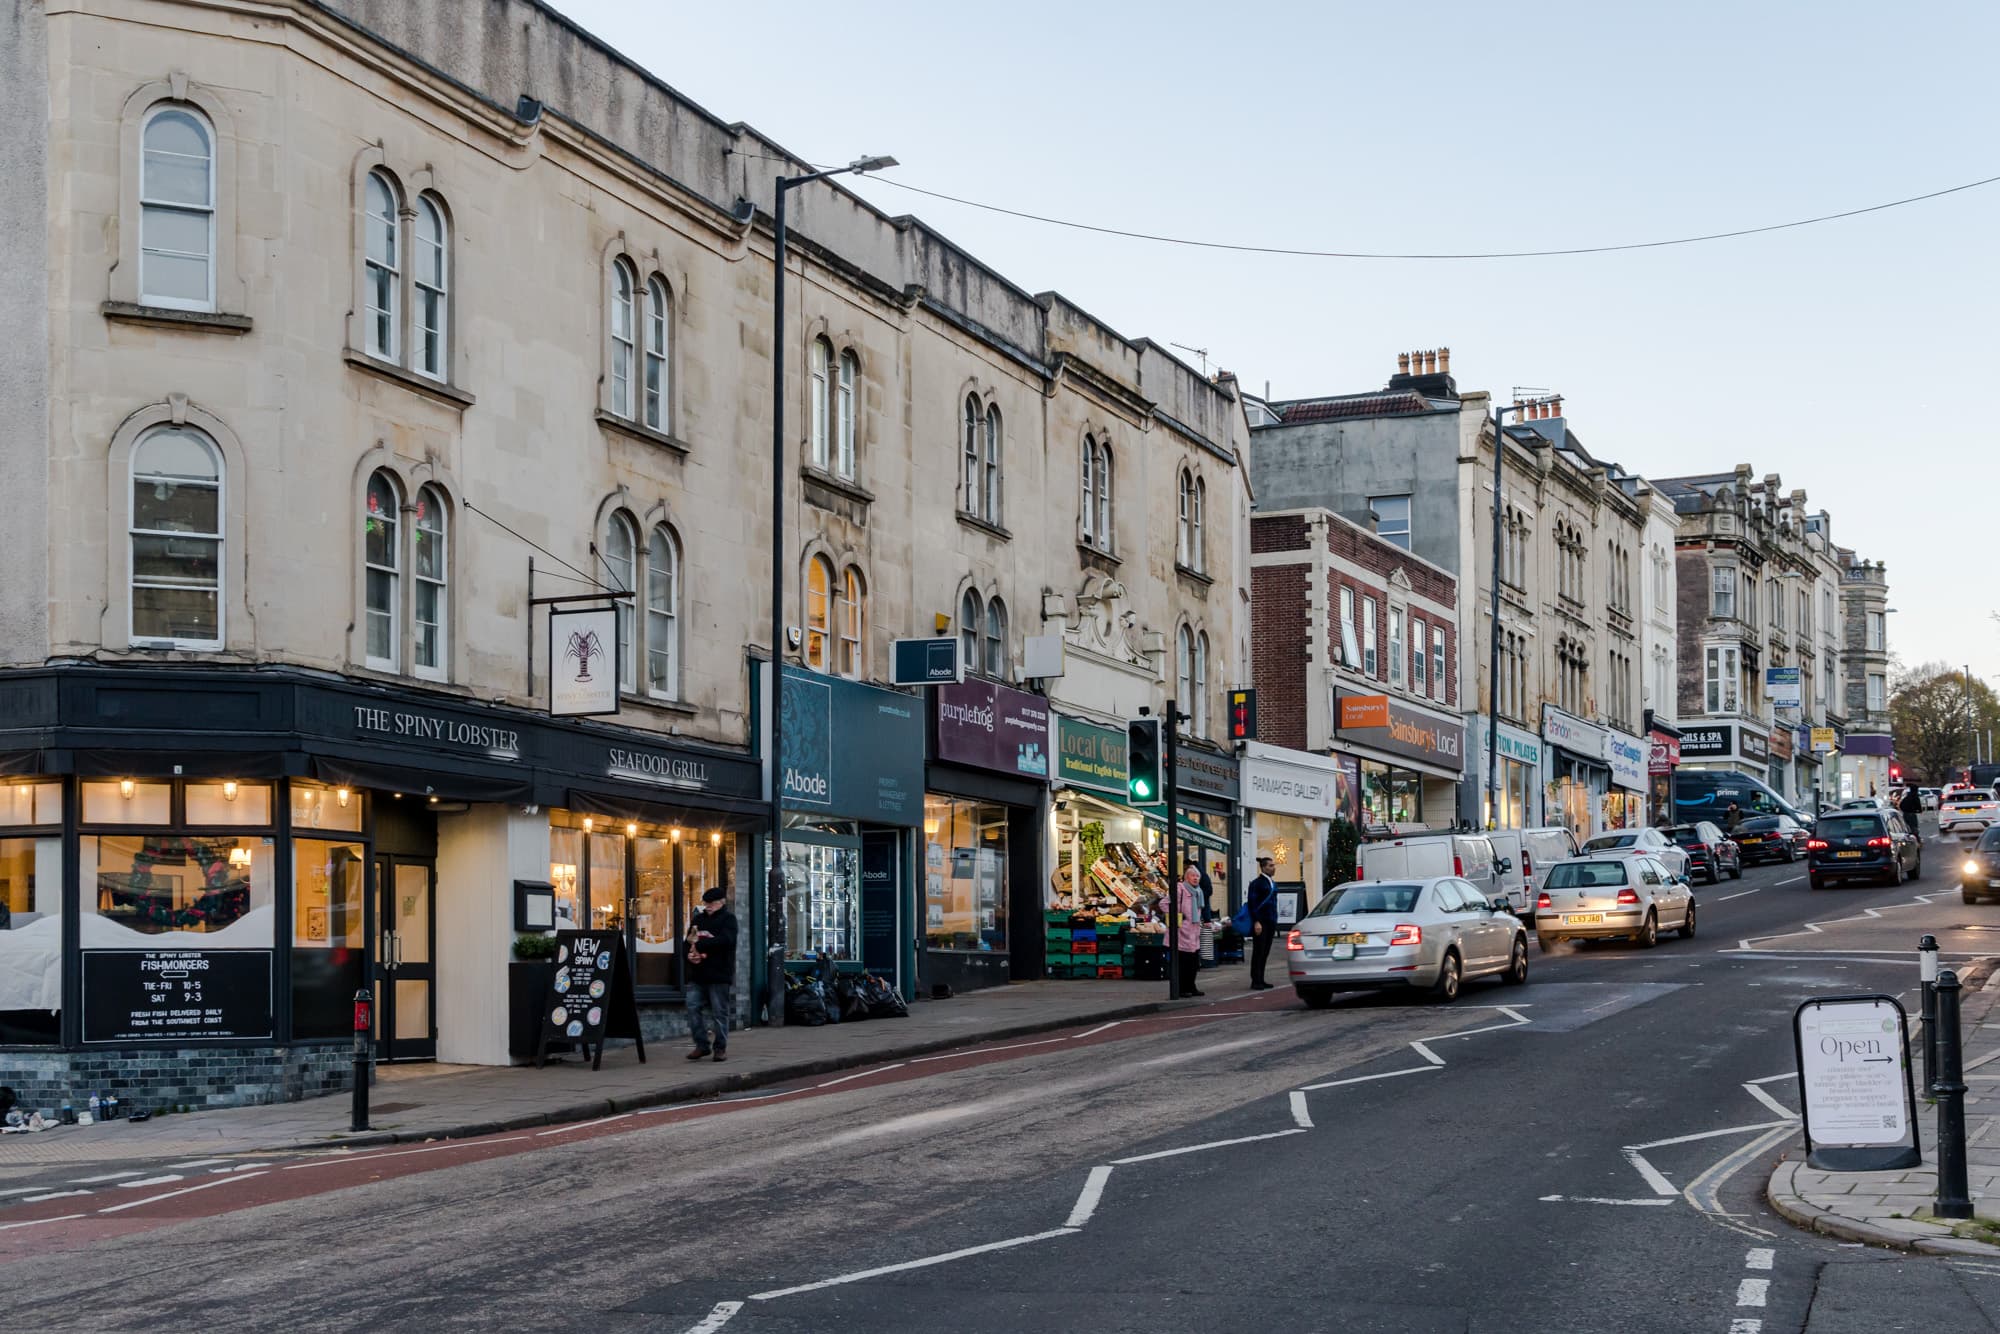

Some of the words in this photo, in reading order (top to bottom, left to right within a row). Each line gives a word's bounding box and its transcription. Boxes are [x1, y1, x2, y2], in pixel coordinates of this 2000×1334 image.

[930, 668, 952, 676] Abode
[1345, 702, 1385, 712] Sainsbury's
[940, 701, 994, 732] purplefrog
[354, 706, 390, 732] THE
[394, 712, 444, 740] SPINY
[448, 721, 519, 751] LOBSTER
[1388, 714, 1436, 752] Sainsbury's
[1437, 729, 1458, 756] Local
[1680, 733, 1698, 742] AILS
[1700, 732, 1707, 741] &
[1708, 732, 1722, 741] SPA
[1060, 726, 1097, 759] Local
[1514, 740, 1538, 762] PILATES
[610, 748, 670, 775] SEAFOOD
[672, 760, 708, 781] GRILL
[1066, 757, 1093, 774] Traditional
[1094, 764, 1112, 778] English
[784, 768, 826, 795] Abode
[1716, 788, 1740, 797] prime
[862, 871, 888, 879] Abode
[574, 938, 600, 956] NEW
[141, 960, 209, 971] FISHMONGERS
[575, 956, 594, 965] SPINY
[143, 982, 172, 990] TUE-FRI
[183, 981, 201, 990] 10-5
[151, 994, 166, 1002] SAT
[184, 992, 202, 1001] 9-3
[1820, 1036, 1880, 1062] Open
